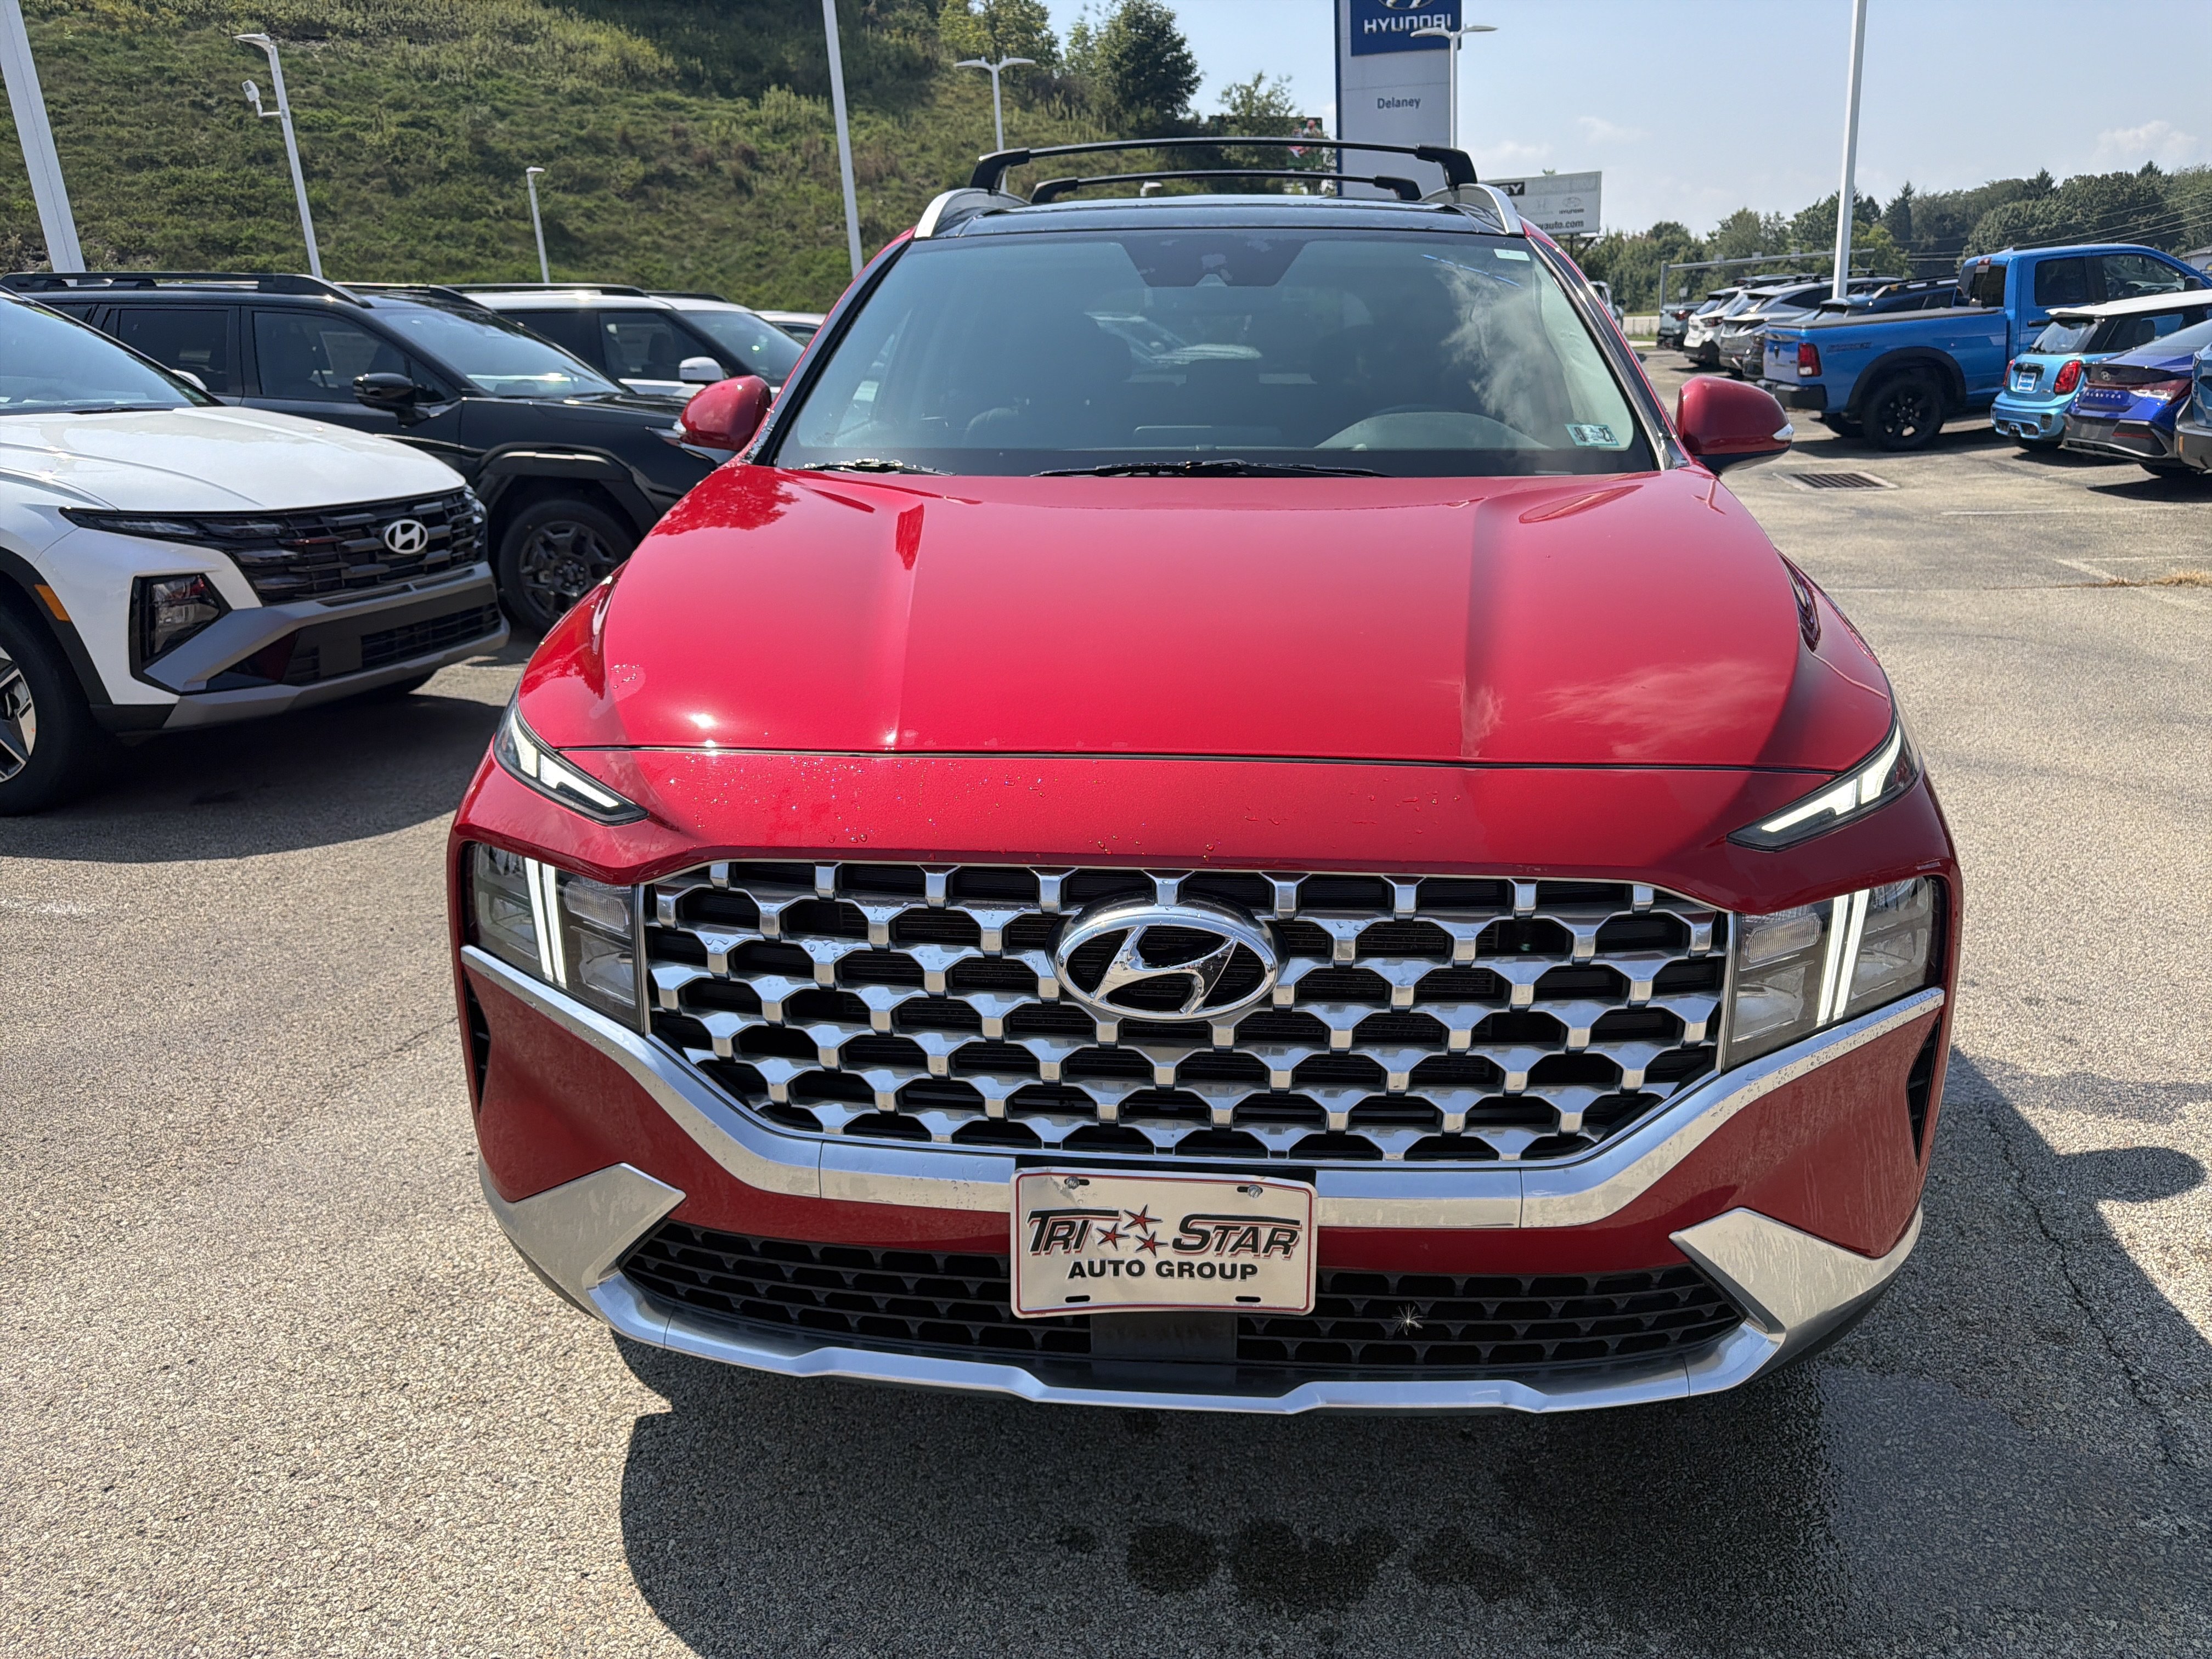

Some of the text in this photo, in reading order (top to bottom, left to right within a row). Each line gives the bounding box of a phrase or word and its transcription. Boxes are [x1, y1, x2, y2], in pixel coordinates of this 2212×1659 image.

[1364, 14, 1451, 34] HYUNDAI
[1377, 97, 1421, 109] Delaney
[1497, 183, 1522, 194] EY
[1536, 221, 1584, 230] yauto.com
[1027, 1209, 1302, 1259] TRI STAR
[1068, 1259, 1258, 1280] AUTO GROUP
